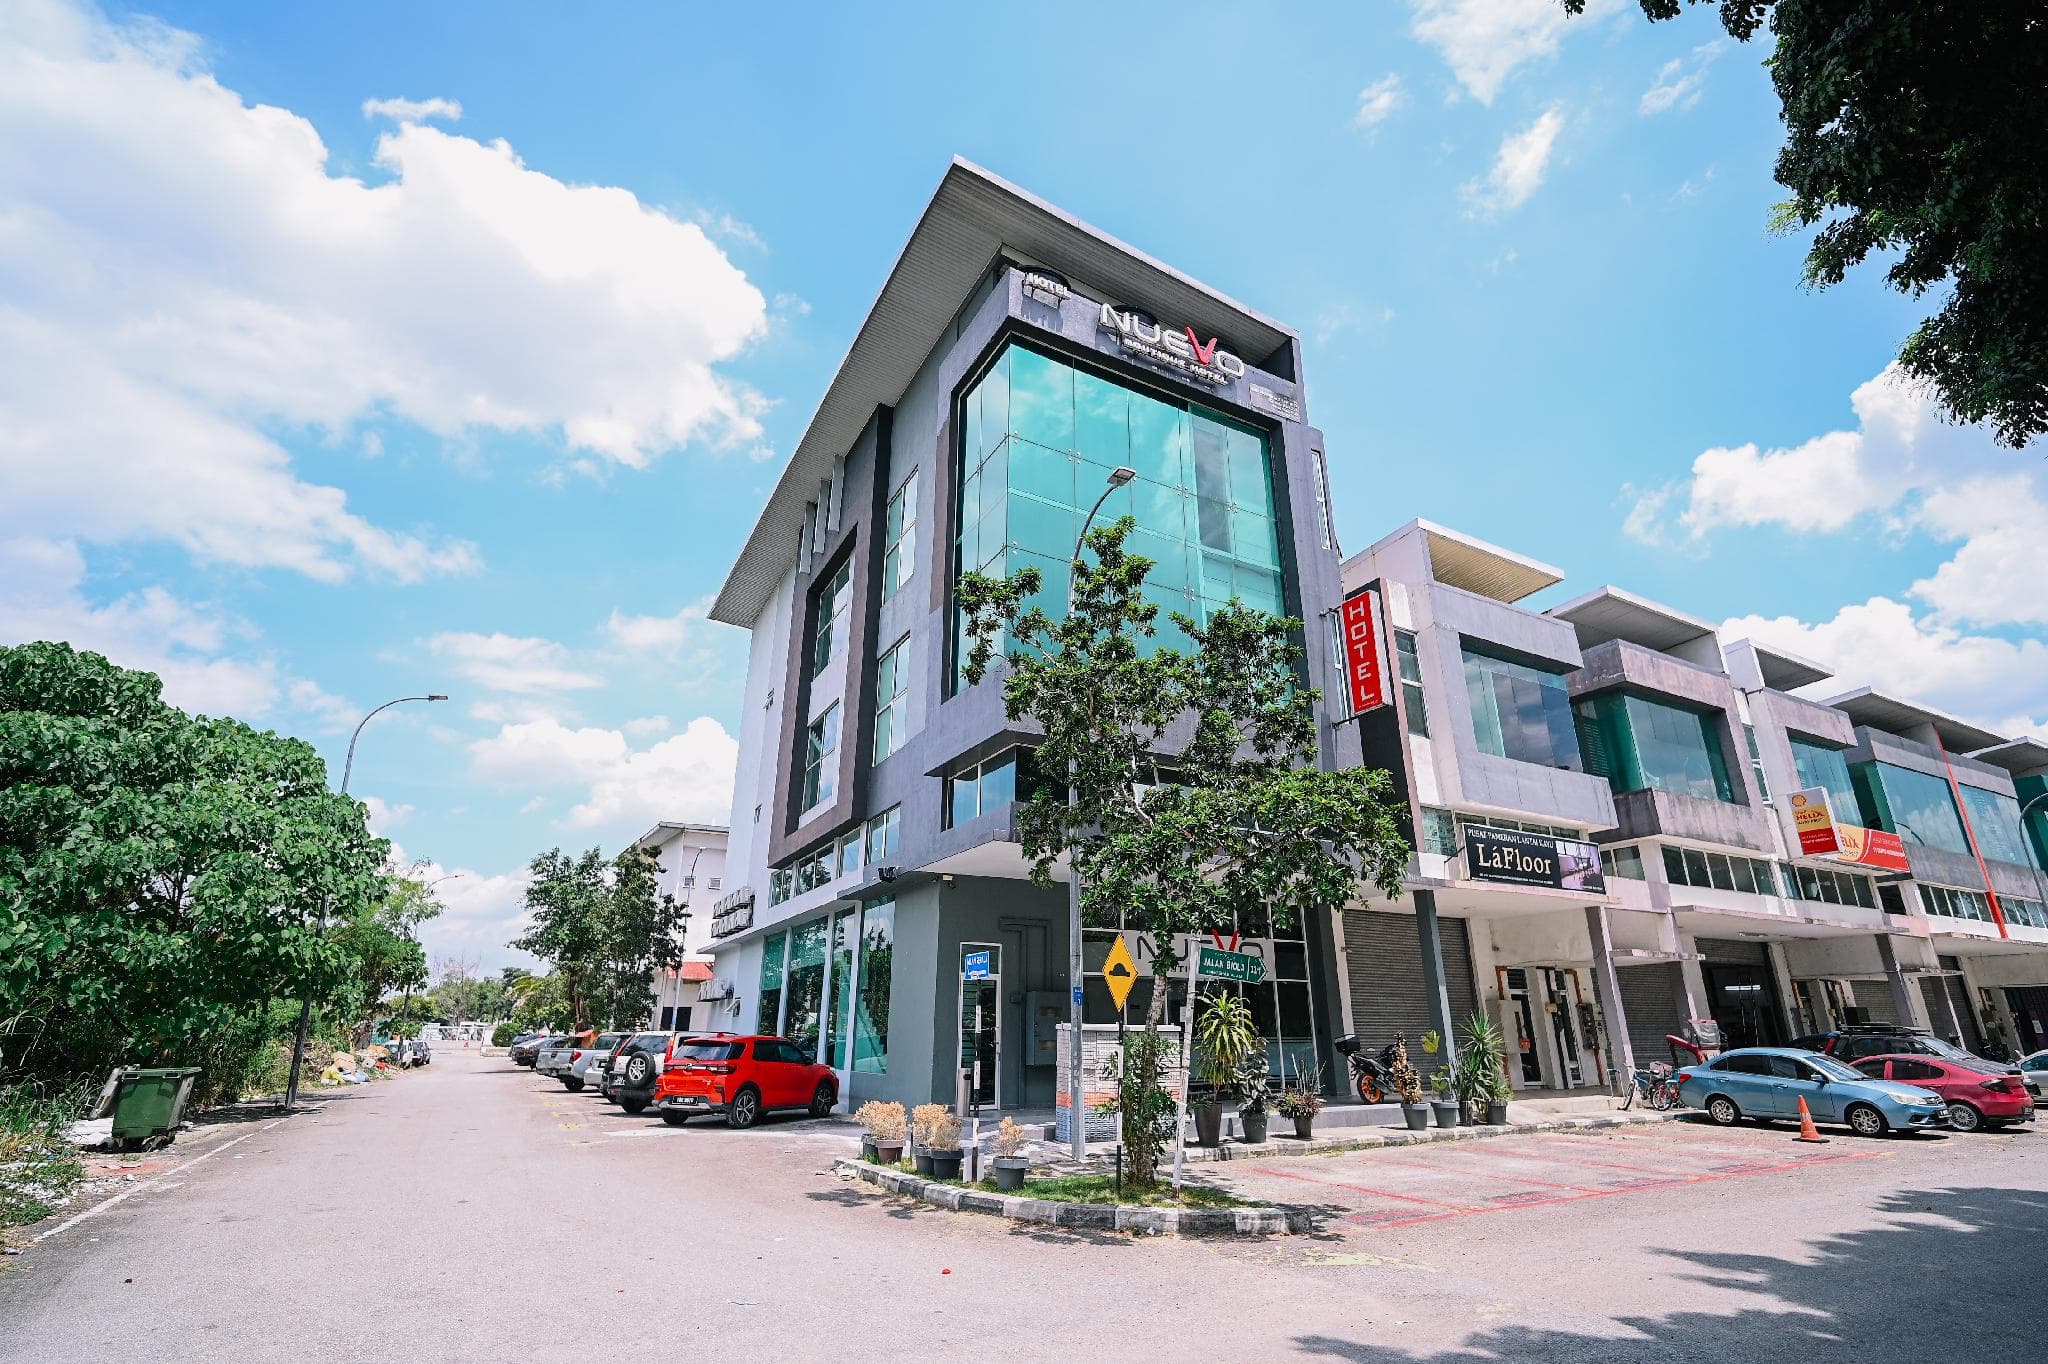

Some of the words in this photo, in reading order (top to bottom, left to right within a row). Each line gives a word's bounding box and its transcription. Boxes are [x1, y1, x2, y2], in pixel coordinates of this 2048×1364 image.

[1025, 272, 1071, 300] HOTEL
[1099, 303, 1244, 379] NUEVO
[1189, 364, 1229, 386] HOTEL
[1348, 600, 1375, 702] HOTEL
